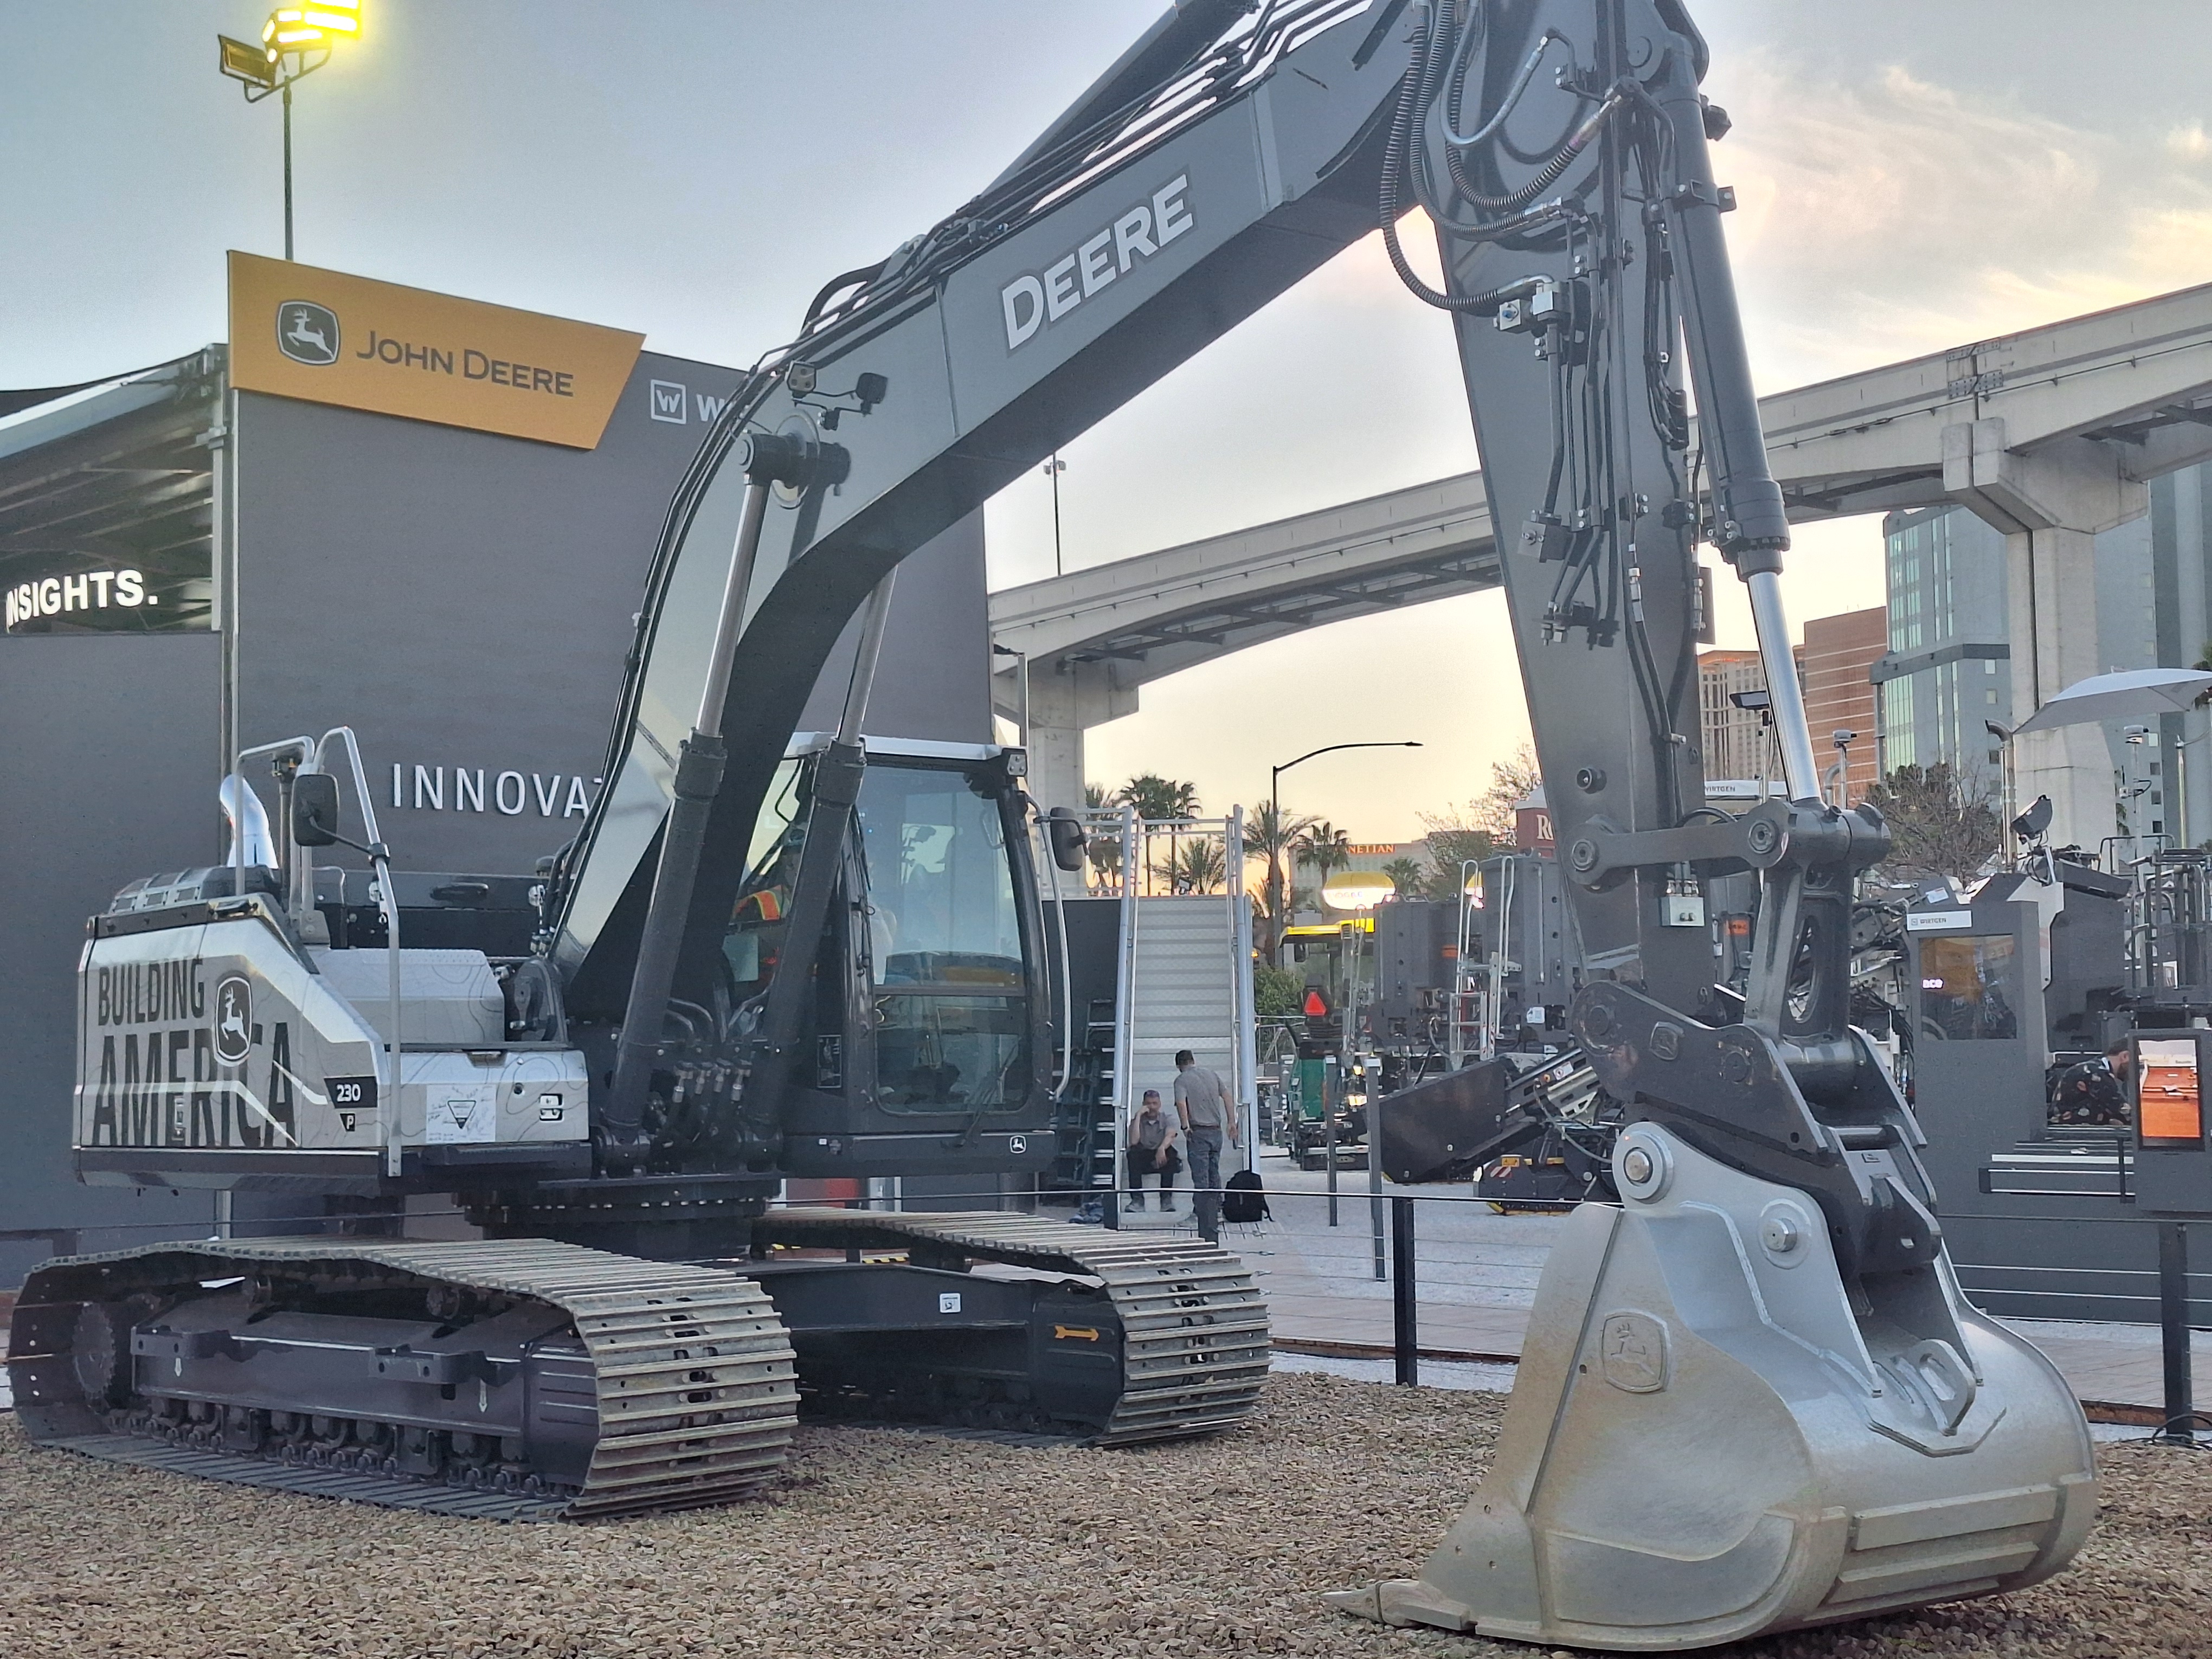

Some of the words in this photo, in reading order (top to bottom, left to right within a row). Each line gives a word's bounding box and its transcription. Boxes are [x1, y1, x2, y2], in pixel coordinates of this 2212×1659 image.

[1002, 173, 1193, 350] DEERE
[356, 330, 454, 375] JOHN
[464, 349, 574, 397] DEERE
[394, 763, 603, 818] INNOVA
[1346, 845, 1394, 853] NETIAN
[98, 955, 205, 1026] BUILDING
[93, 1022, 296, 1147] AMERICA
[337, 1083, 361, 1102] 230
[347, 1115, 354, 1130] P
